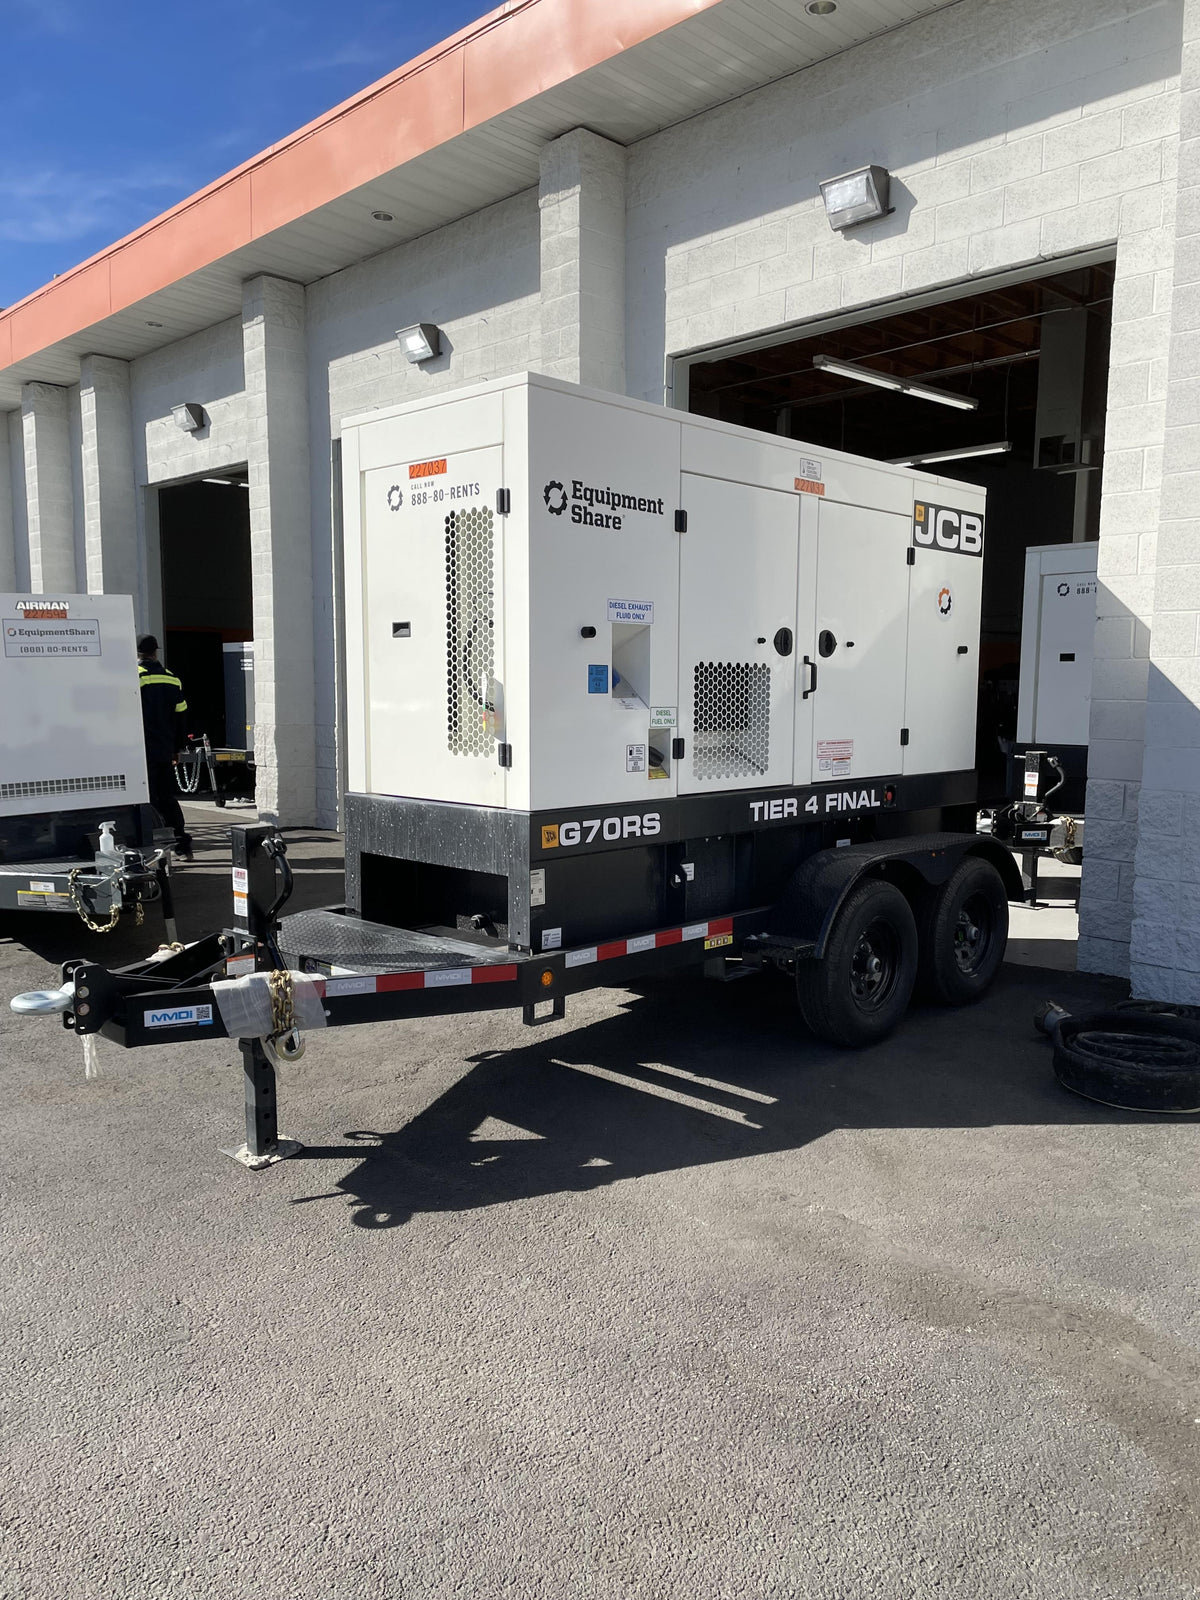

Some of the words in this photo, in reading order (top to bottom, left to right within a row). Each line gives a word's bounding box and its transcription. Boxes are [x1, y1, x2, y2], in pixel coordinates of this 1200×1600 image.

[409, 459, 447, 479] 227037
[411, 482, 480, 506] 888-80-RENTS
[424, 480, 434, 488] NOW
[571, 479, 664, 515] Equipment
[915, 506, 982, 553] JCB
[16, 601, 69, 610] AIRMAN
[609, 601, 627, 610] DIESEL
[628, 603, 652, 611] EXHAUST
[616, 611, 631, 620] FLUID
[632, 612, 645, 620] ONLY
[18, 628, 95, 637] EquipmentShare
[749, 797, 798, 822] TIER
[804, 795, 819, 814] 4
[825, 789, 880, 813] FINAL
[559, 812, 661, 847] G70RS
